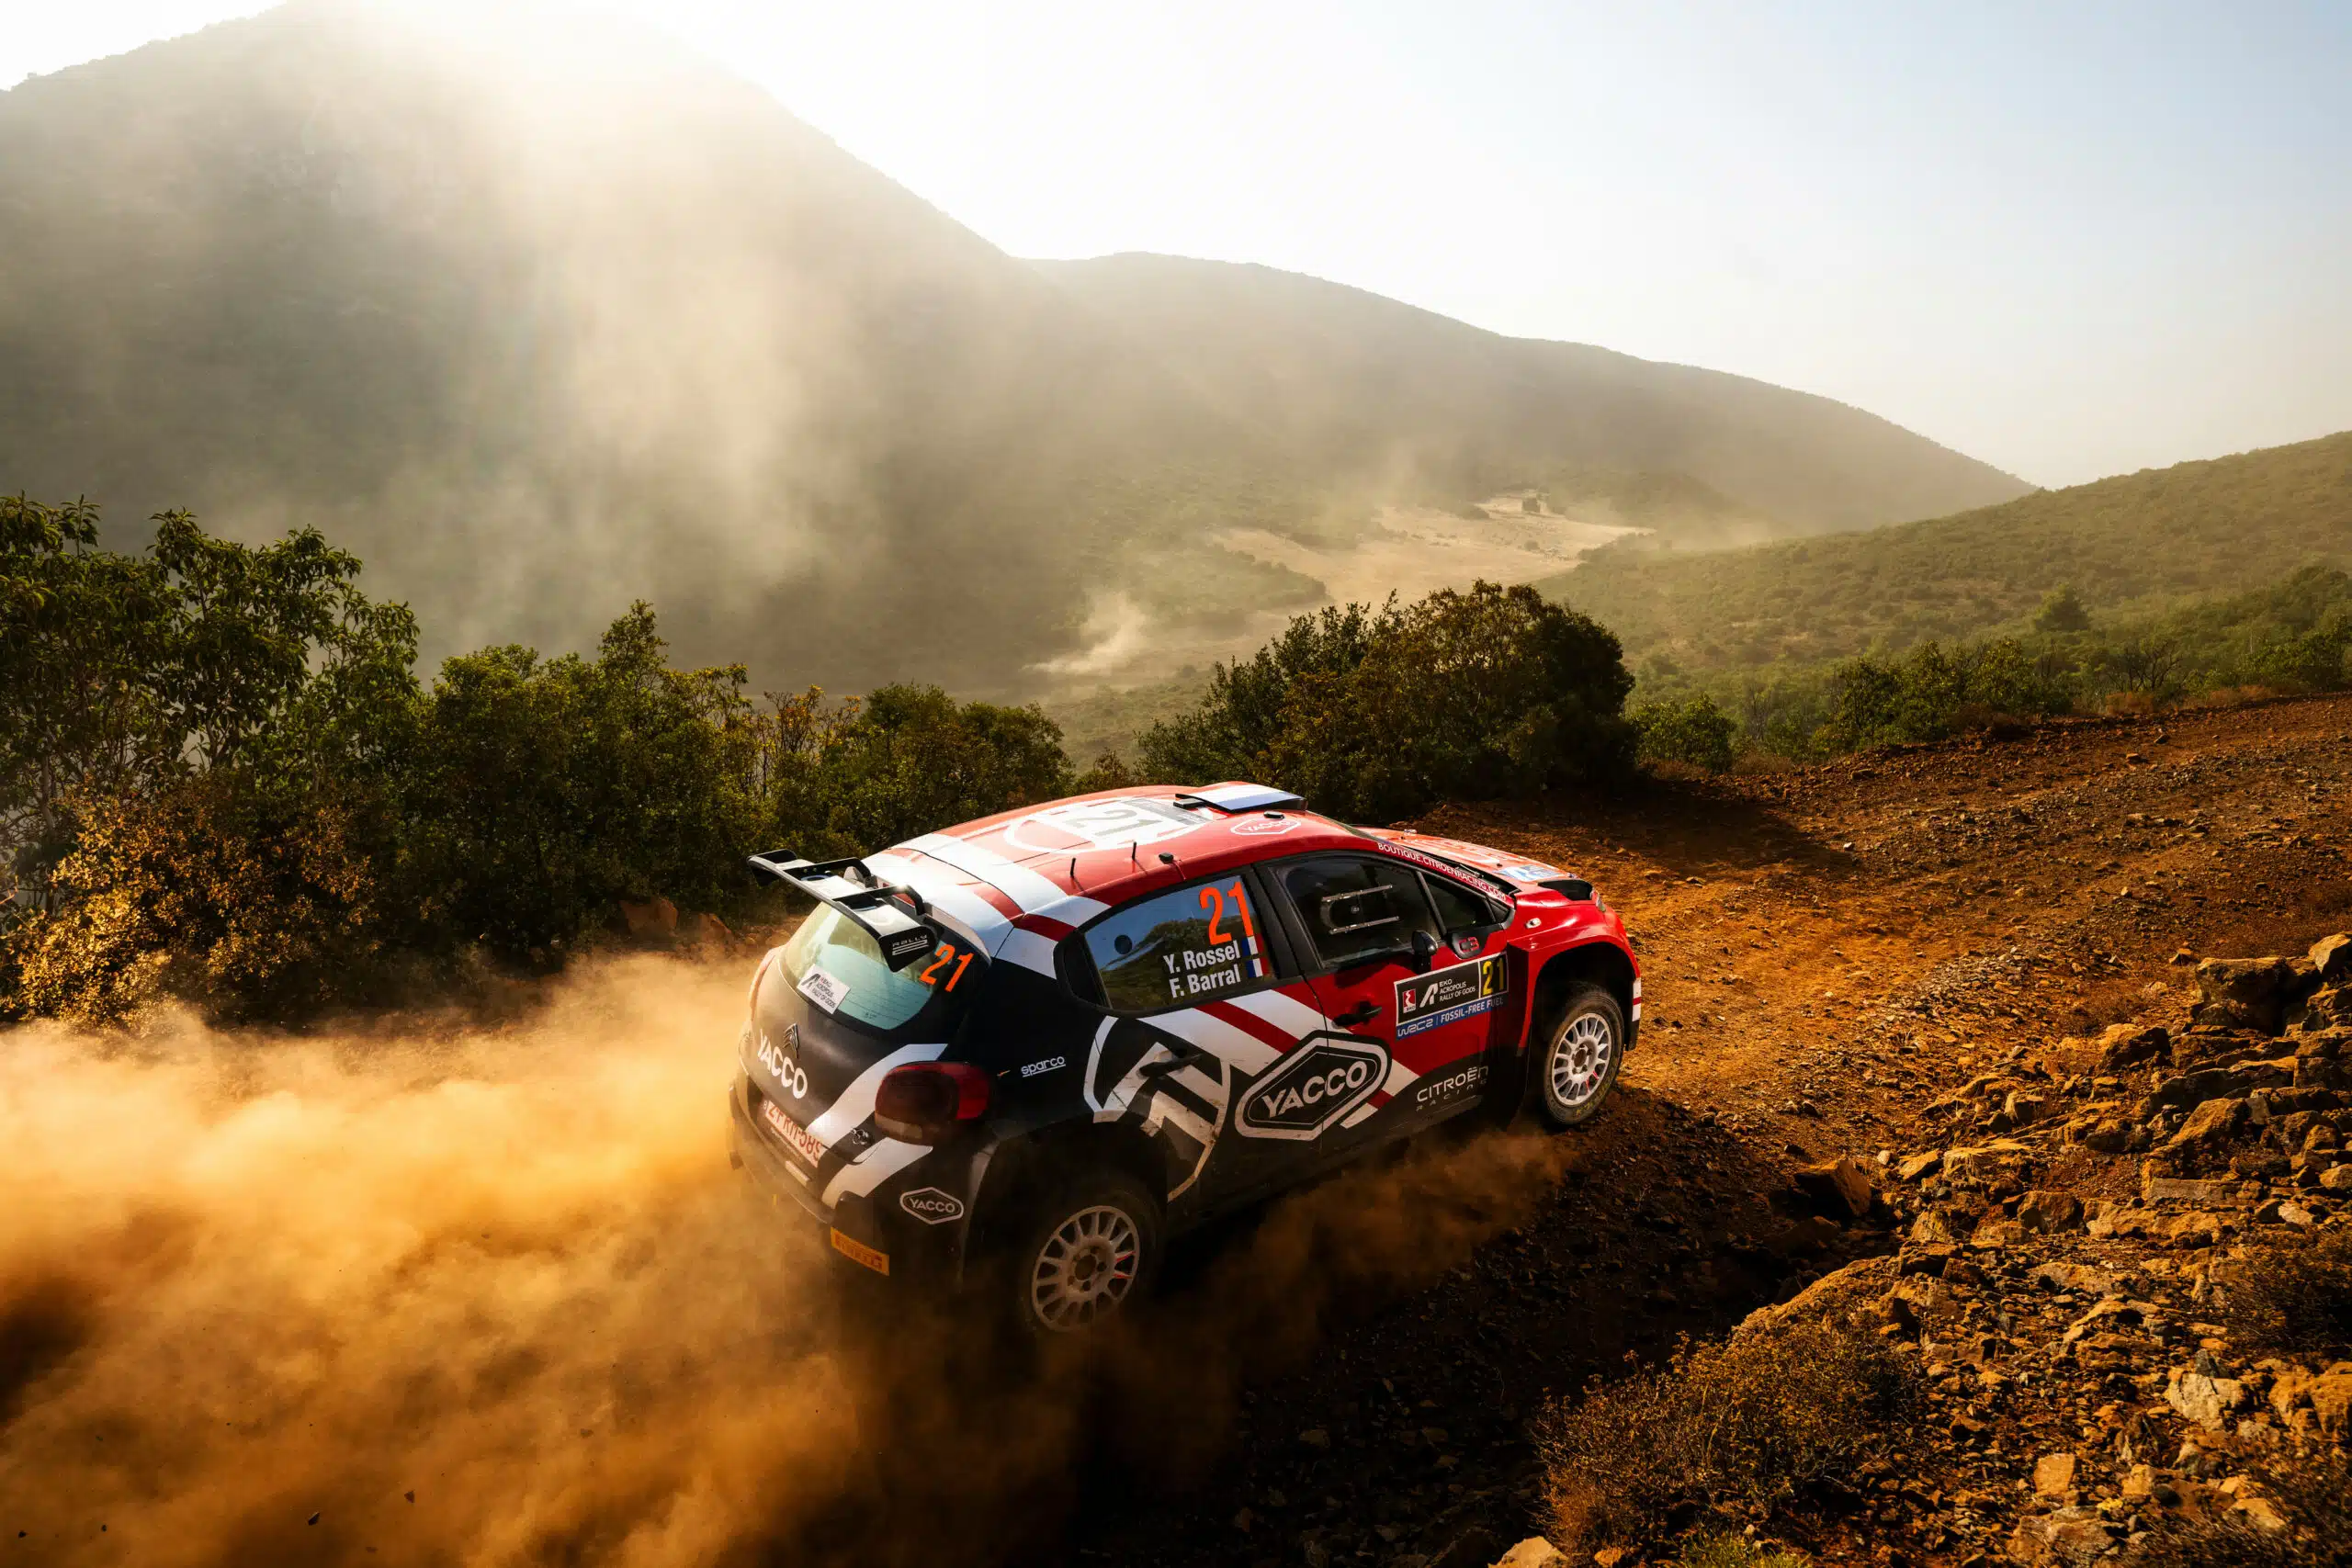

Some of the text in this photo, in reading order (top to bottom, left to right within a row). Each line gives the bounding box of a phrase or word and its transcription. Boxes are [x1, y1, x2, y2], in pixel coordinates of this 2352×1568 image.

[1199, 881, 1254, 945] 21
[1163, 940, 1240, 974] Y. Rossel
[1458, 937, 1479, 953] C3
[919, 943, 974, 992] 21
[1169, 964, 1240, 998] F. Barral
[1439, 978, 1453, 987] EKO
[1482, 957, 1504, 996] 21
[1439, 981, 1466, 995] ACROPOLIS
[1439, 986, 1476, 1002] RALLY OF GODS
[1397, 997, 1504, 1037] WRC2 FOSSIL-FREE FUEL
[757, 1029, 808, 1100] YACCO
[1021, 1055, 1065, 1077] sparco
[1261, 1061, 1367, 1118] YACCO
[910, 1198, 956, 1213] YACCO
